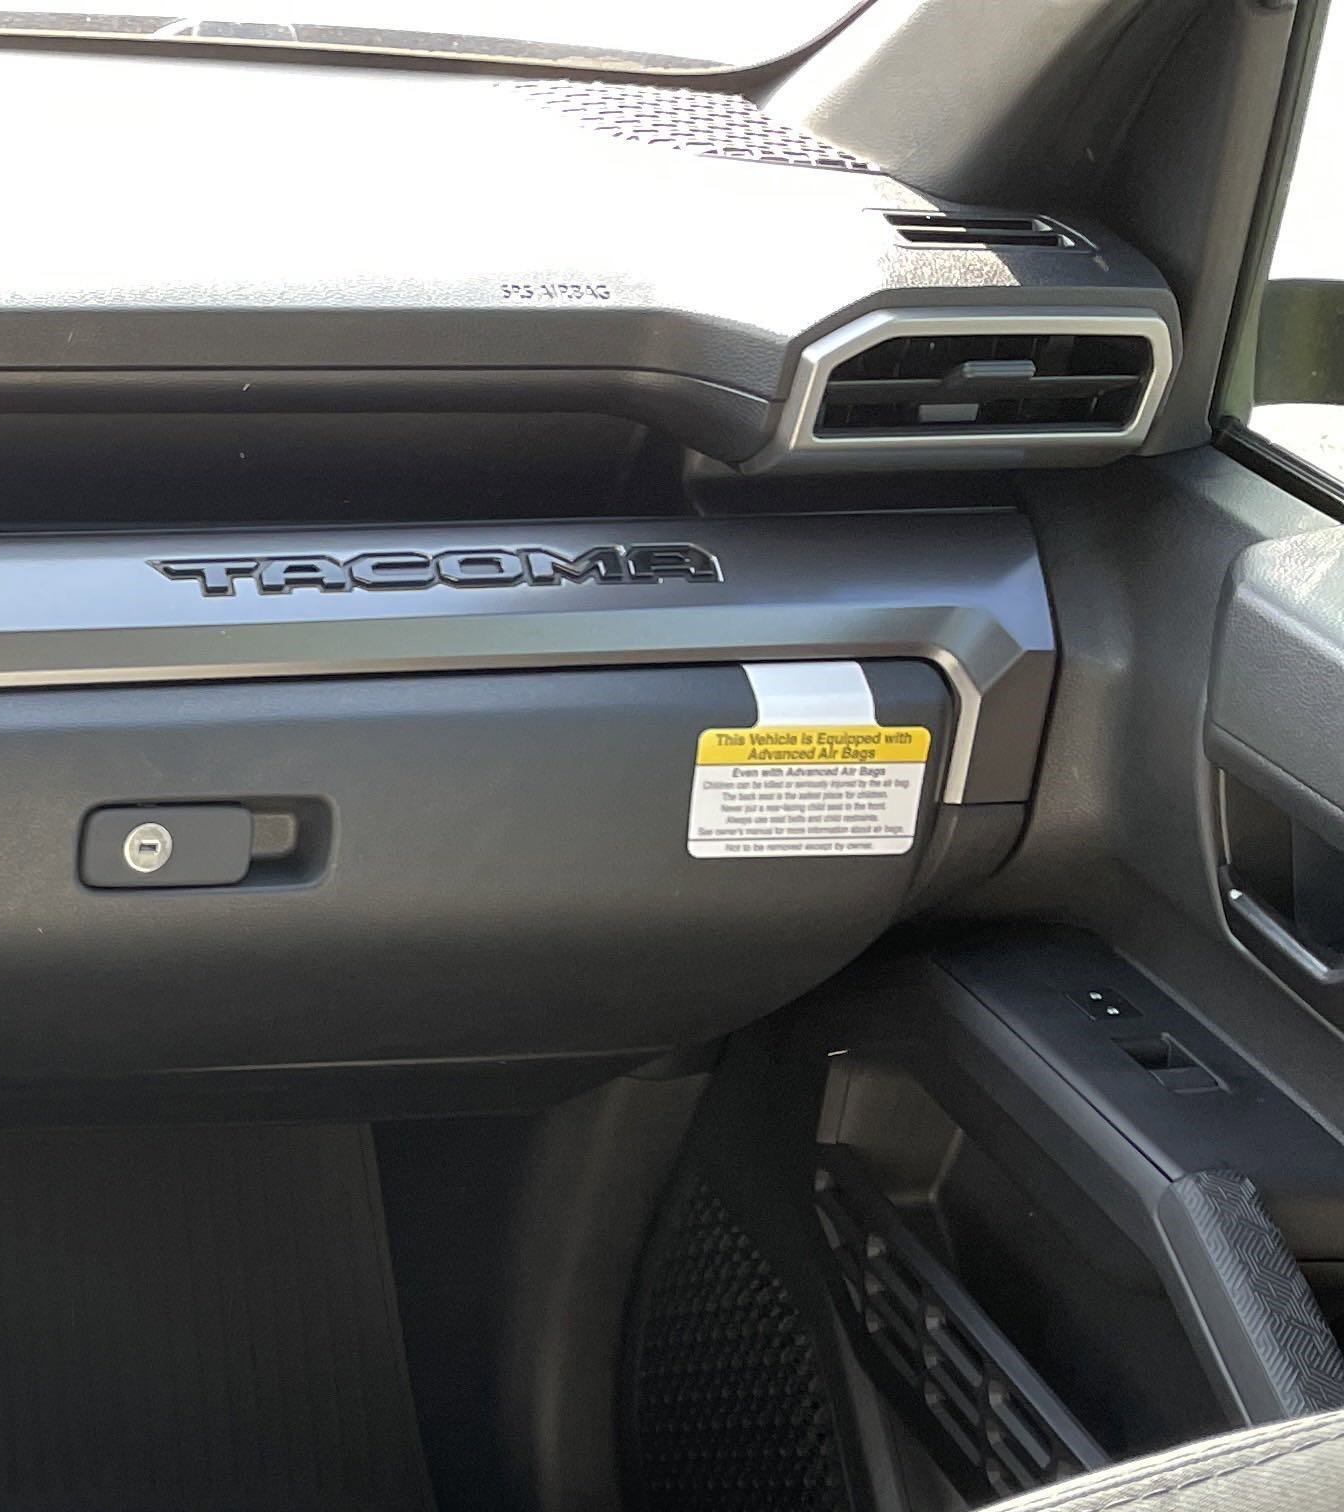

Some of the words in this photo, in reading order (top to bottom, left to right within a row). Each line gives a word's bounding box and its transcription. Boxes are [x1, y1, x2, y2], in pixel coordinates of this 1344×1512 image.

[146, 543, 724, 598] TACOMA
[716, 733, 745, 746] This
[749, 733, 797, 746] Vehicle
[817, 732, 881, 748] Equipped
[884, 732, 912, 744] with
[747, 747, 816, 760] Advanced
[818, 746, 838, 759] Air
[841, 745, 875, 761] Bags
[732, 767, 759, 778] Even
[761, 767, 783, 777] with
[786, 766, 838, 776] Advanced
[840, 766, 857, 776] Air
[859, 765, 886, 778] Bags
